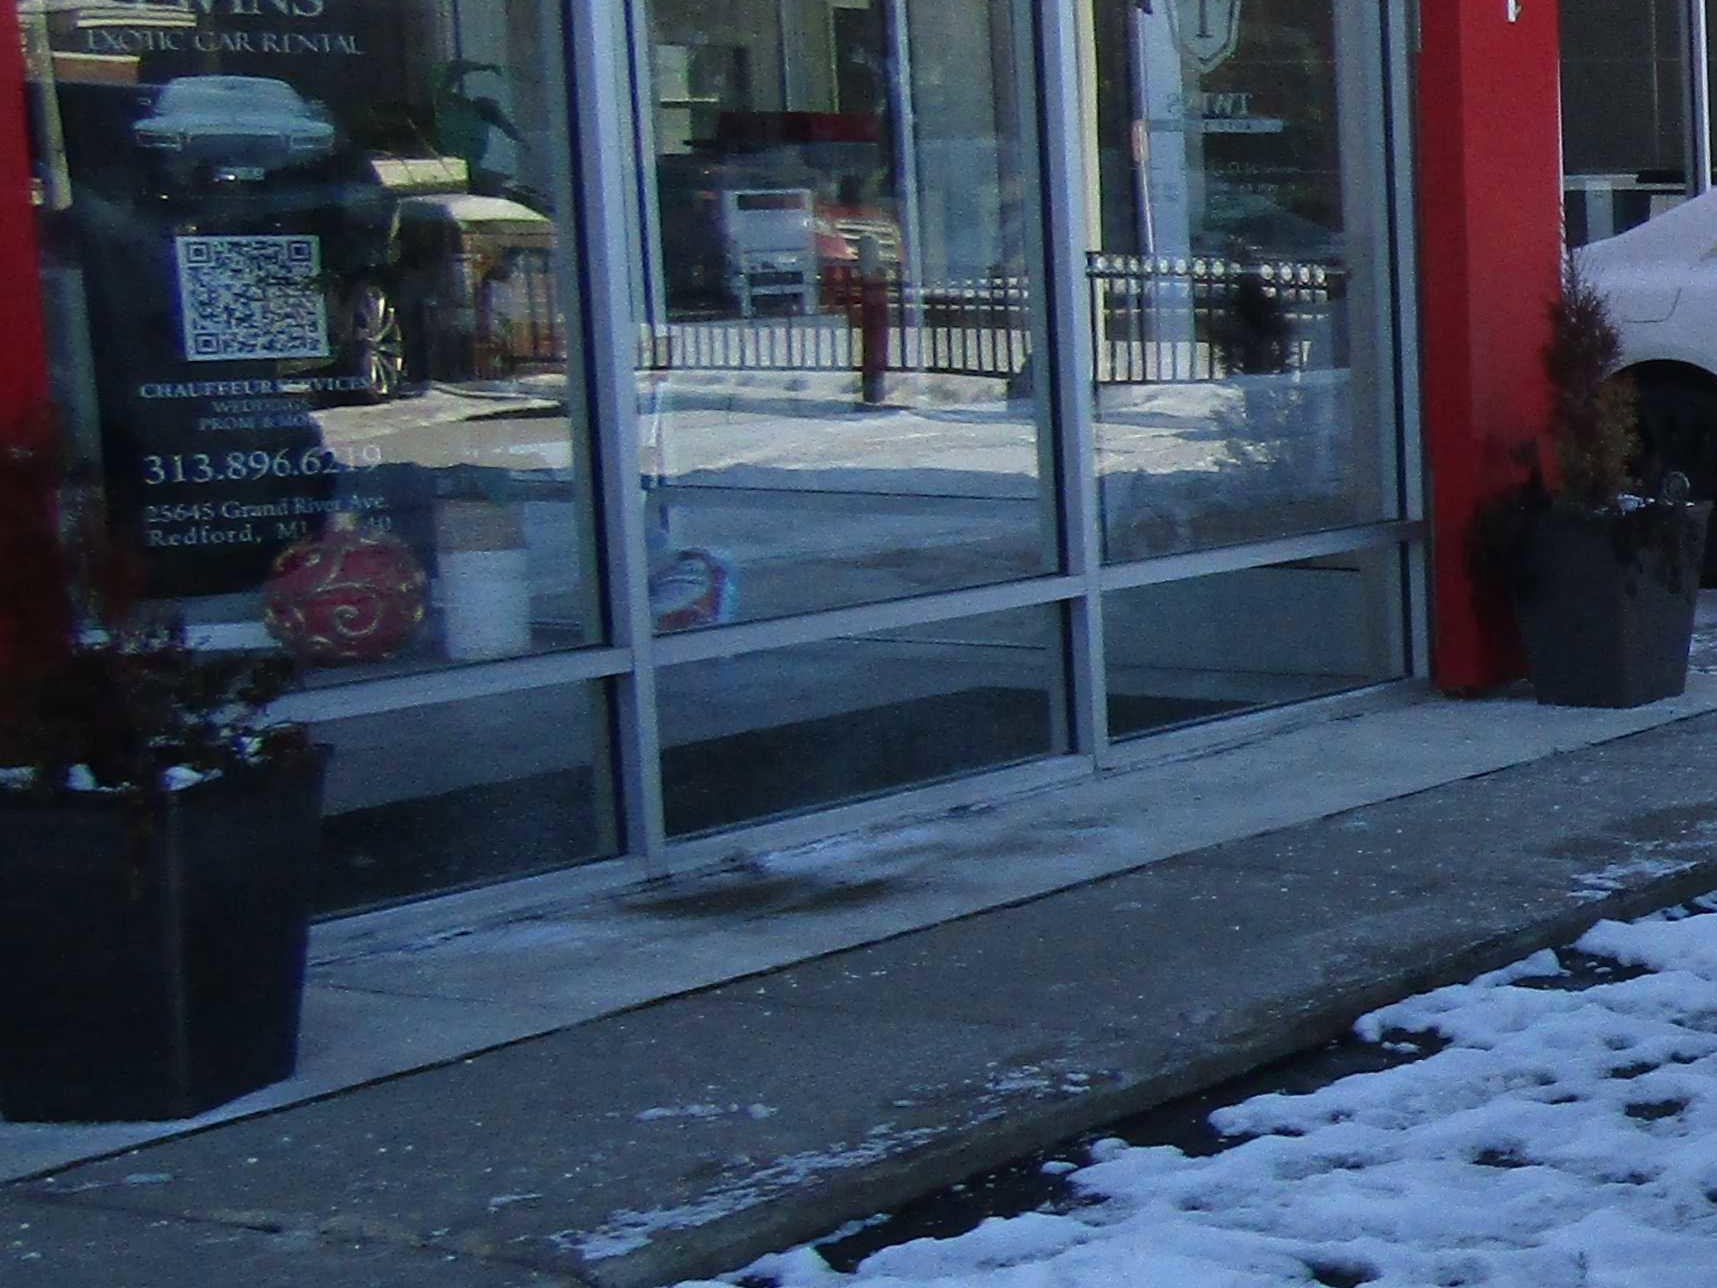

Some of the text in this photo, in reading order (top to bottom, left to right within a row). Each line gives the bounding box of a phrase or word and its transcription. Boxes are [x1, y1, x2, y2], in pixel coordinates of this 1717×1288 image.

[88, 29, 367, 55] EXOTIC CAR RENTAL
[139, 376, 371, 399] CHAUFFEUR SVICES
[144, 444, 382, 485] 313.896.6219
[148, 502, 216, 523] 25645
[222, 498, 288, 520] Grand
[293, 495, 343, 513] River
[149, 523, 262, 547] Redford,
